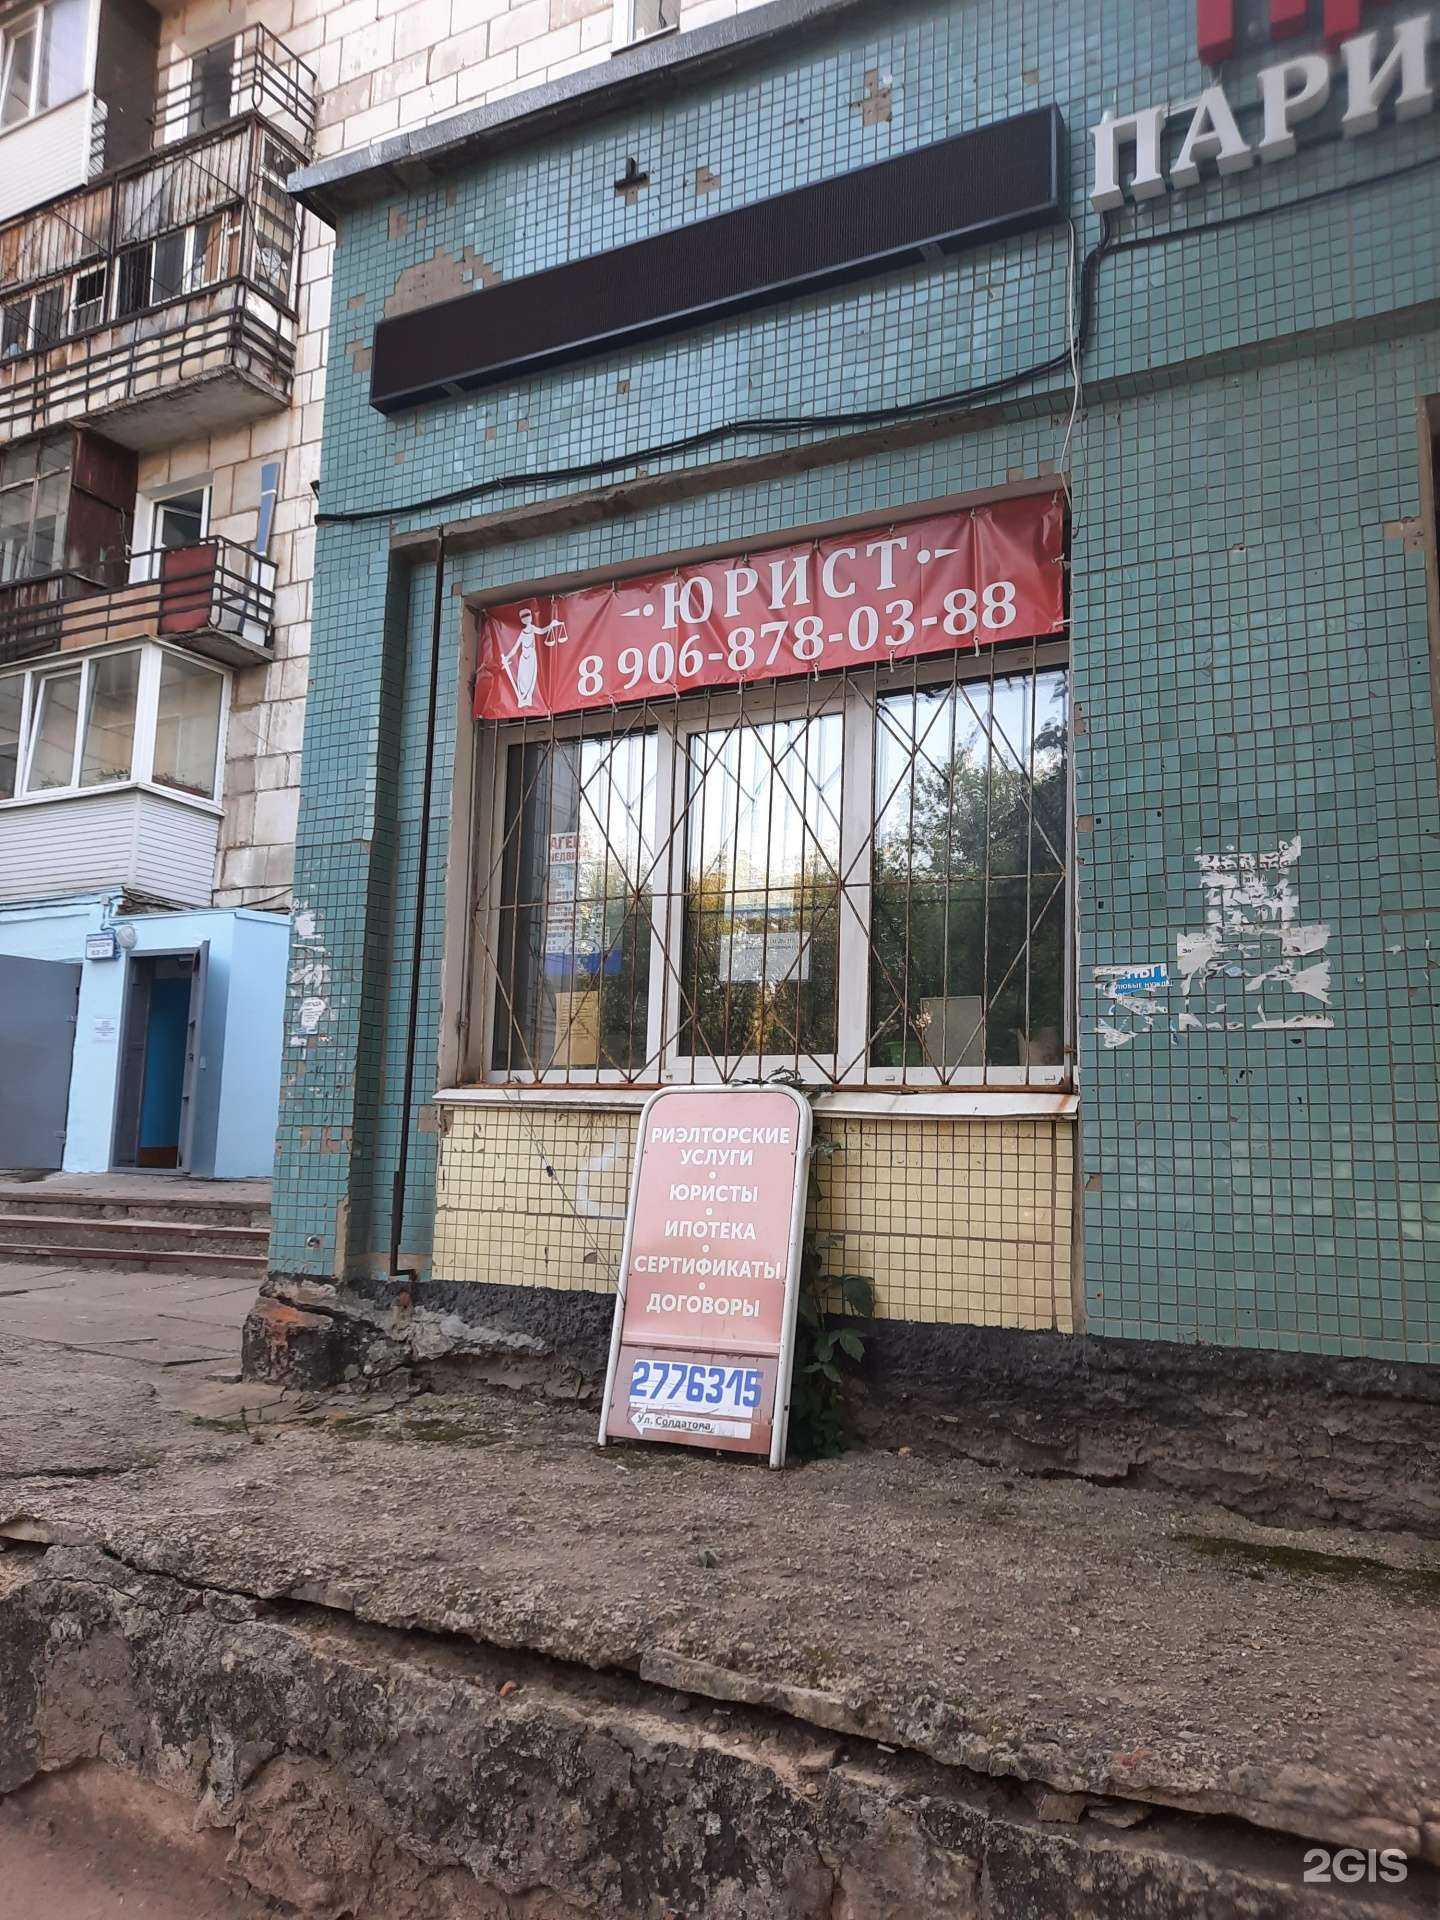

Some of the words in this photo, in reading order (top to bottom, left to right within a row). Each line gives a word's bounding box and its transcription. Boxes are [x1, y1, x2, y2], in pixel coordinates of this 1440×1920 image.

[1089, 13, 1433, 206] ПАРИ
[661, 536, 909, 629] ЮРИСТ
[577, 655, 604, 697] 8
[617, 580, 1017, 690] 906-878-03-88
[651, 1126, 790, 1145] РИЭЛТОРСКИЕ
[680, 1148, 753, 1167] УСЛУГИ
[669, 1184, 758, 1203] ЮРИСТЫ
[664, 1220, 757, 1241] ИПОТЕКА
[634, 1255, 781, 1280] СЕРТИФИКАТЫ
[646, 1293, 760, 1318] ДОГОВОРЫ
[630, 1360, 764, 1407] 2776315
